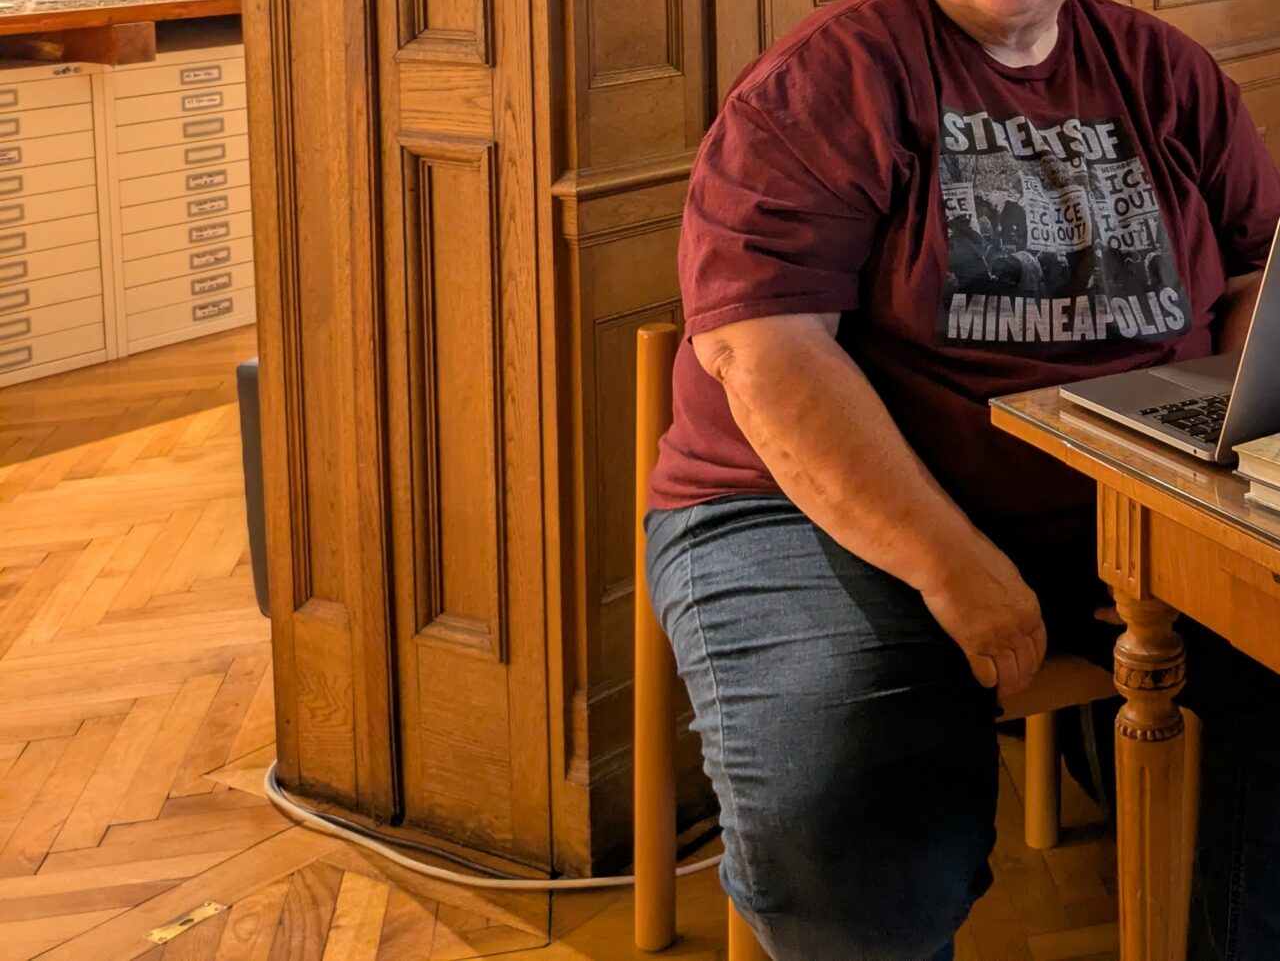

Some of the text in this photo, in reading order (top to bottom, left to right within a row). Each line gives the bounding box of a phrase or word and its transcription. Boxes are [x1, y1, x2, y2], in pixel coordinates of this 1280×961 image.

[1080, 122, 1118, 160] OF
[1054, 202, 1083, 225] ICE
[947, 287, 1186, 342] MINNEAPOLIS
